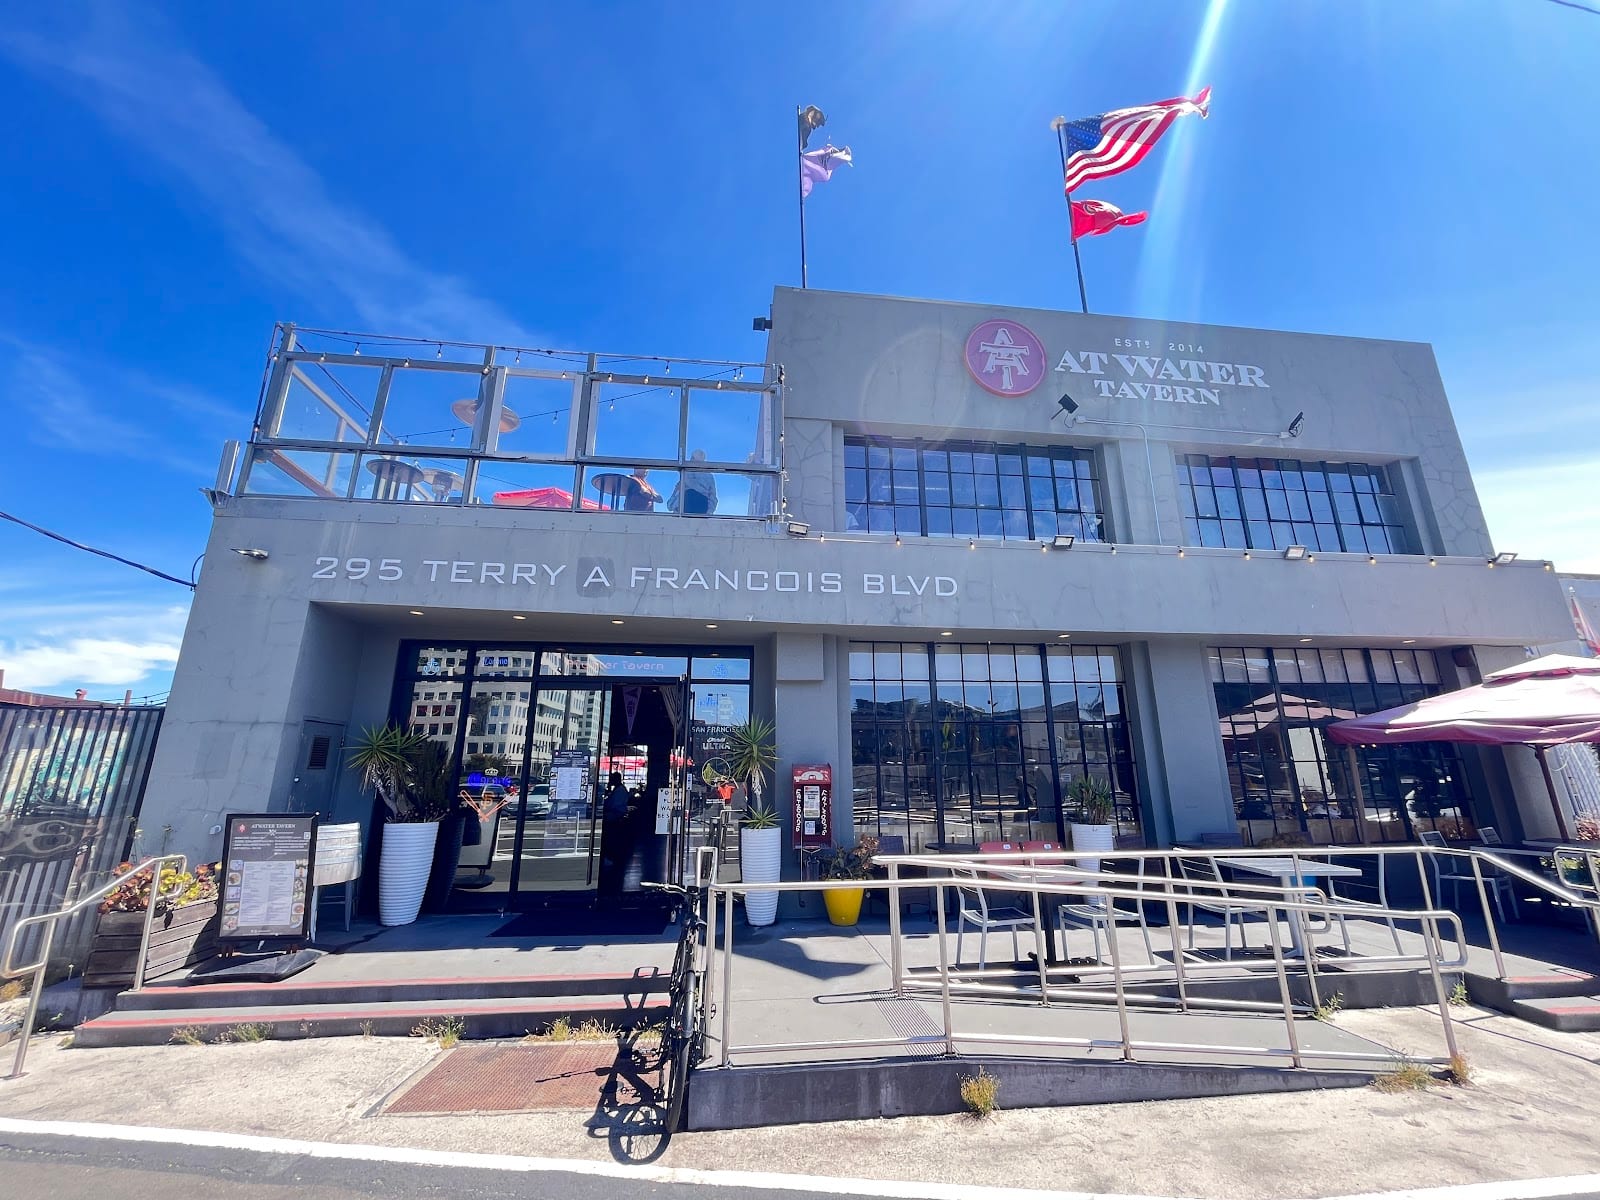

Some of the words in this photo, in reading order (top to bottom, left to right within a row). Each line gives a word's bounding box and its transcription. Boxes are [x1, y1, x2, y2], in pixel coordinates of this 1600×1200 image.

[1168, 342, 1204, 354] 2014
[1094, 379, 1220, 405] TAVERN
[312, 556, 403, 581] 295
[423, 560, 567, 587] TERRY
[583, 566, 610, 588] A
[630, 567, 842, 593] FRANCOIS
[863, 573, 958, 597] BLVD
[702, 742, 731, 751] ULTRA
